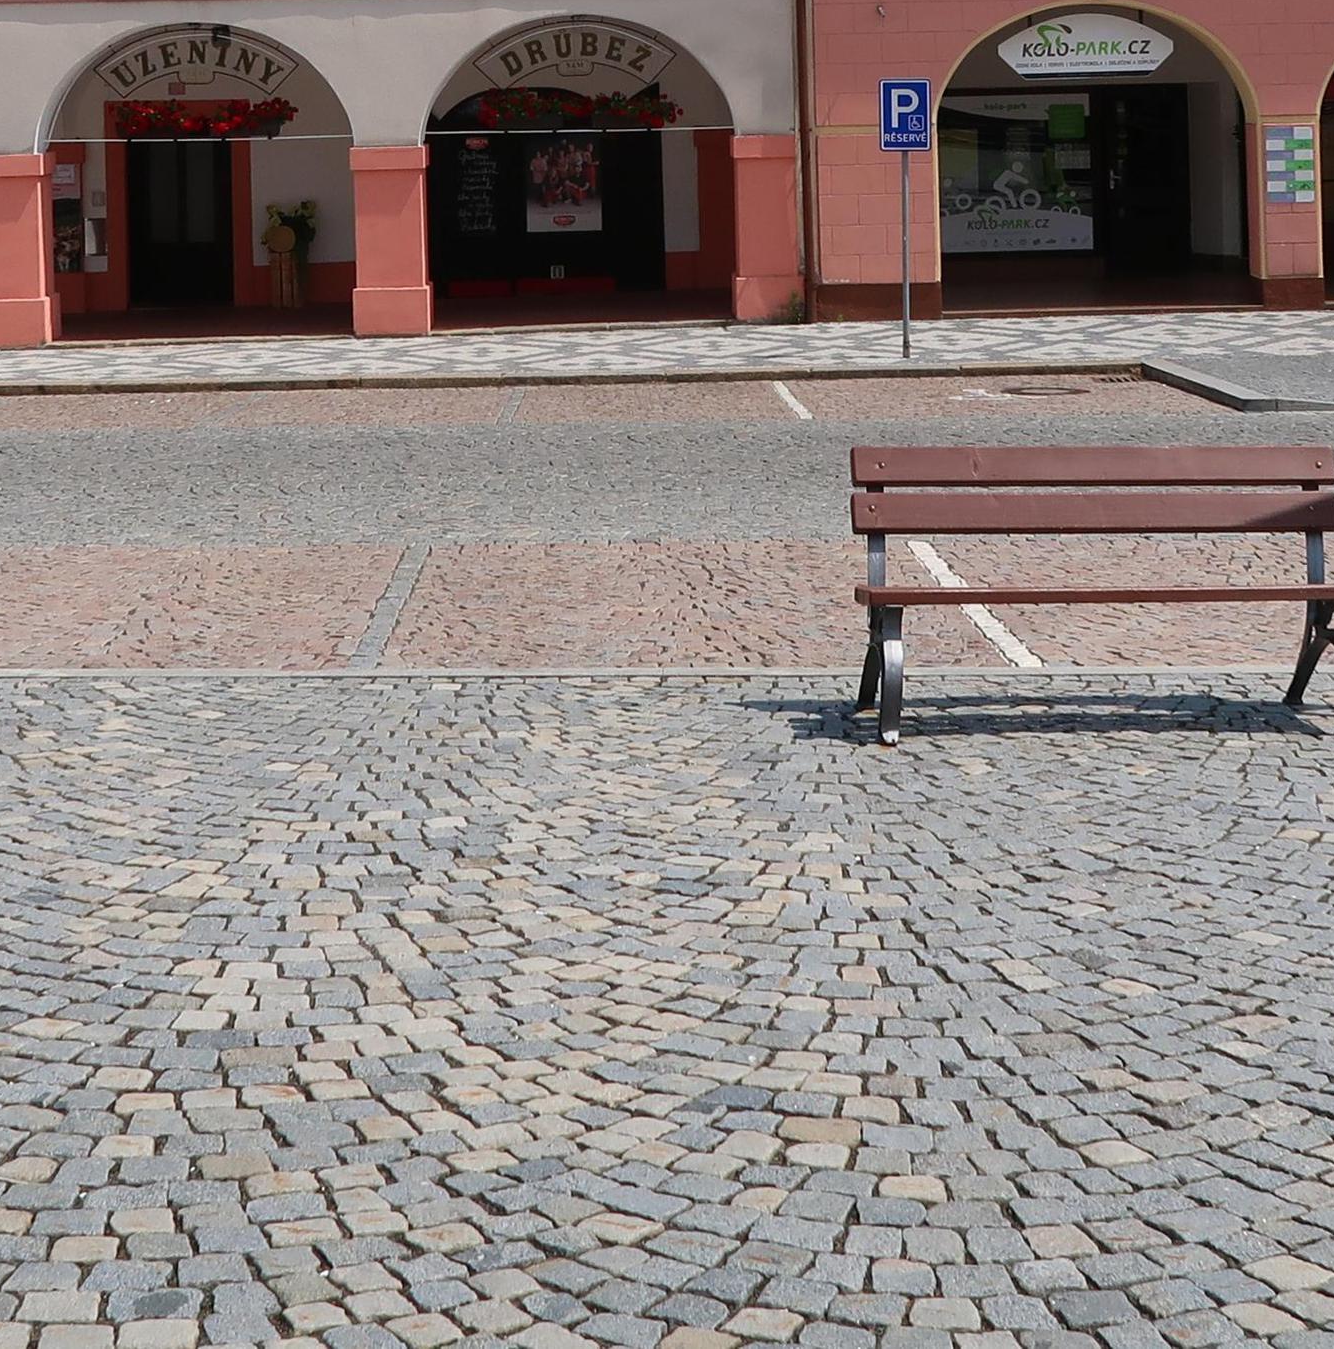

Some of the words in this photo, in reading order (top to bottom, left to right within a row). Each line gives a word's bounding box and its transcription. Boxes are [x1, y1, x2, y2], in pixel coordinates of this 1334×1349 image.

[110, 41, 284, 87] UZENINY
[1022, 40, 1151, 57] KOLO-PARK.CZ
[891, 89, 919, 128] P
